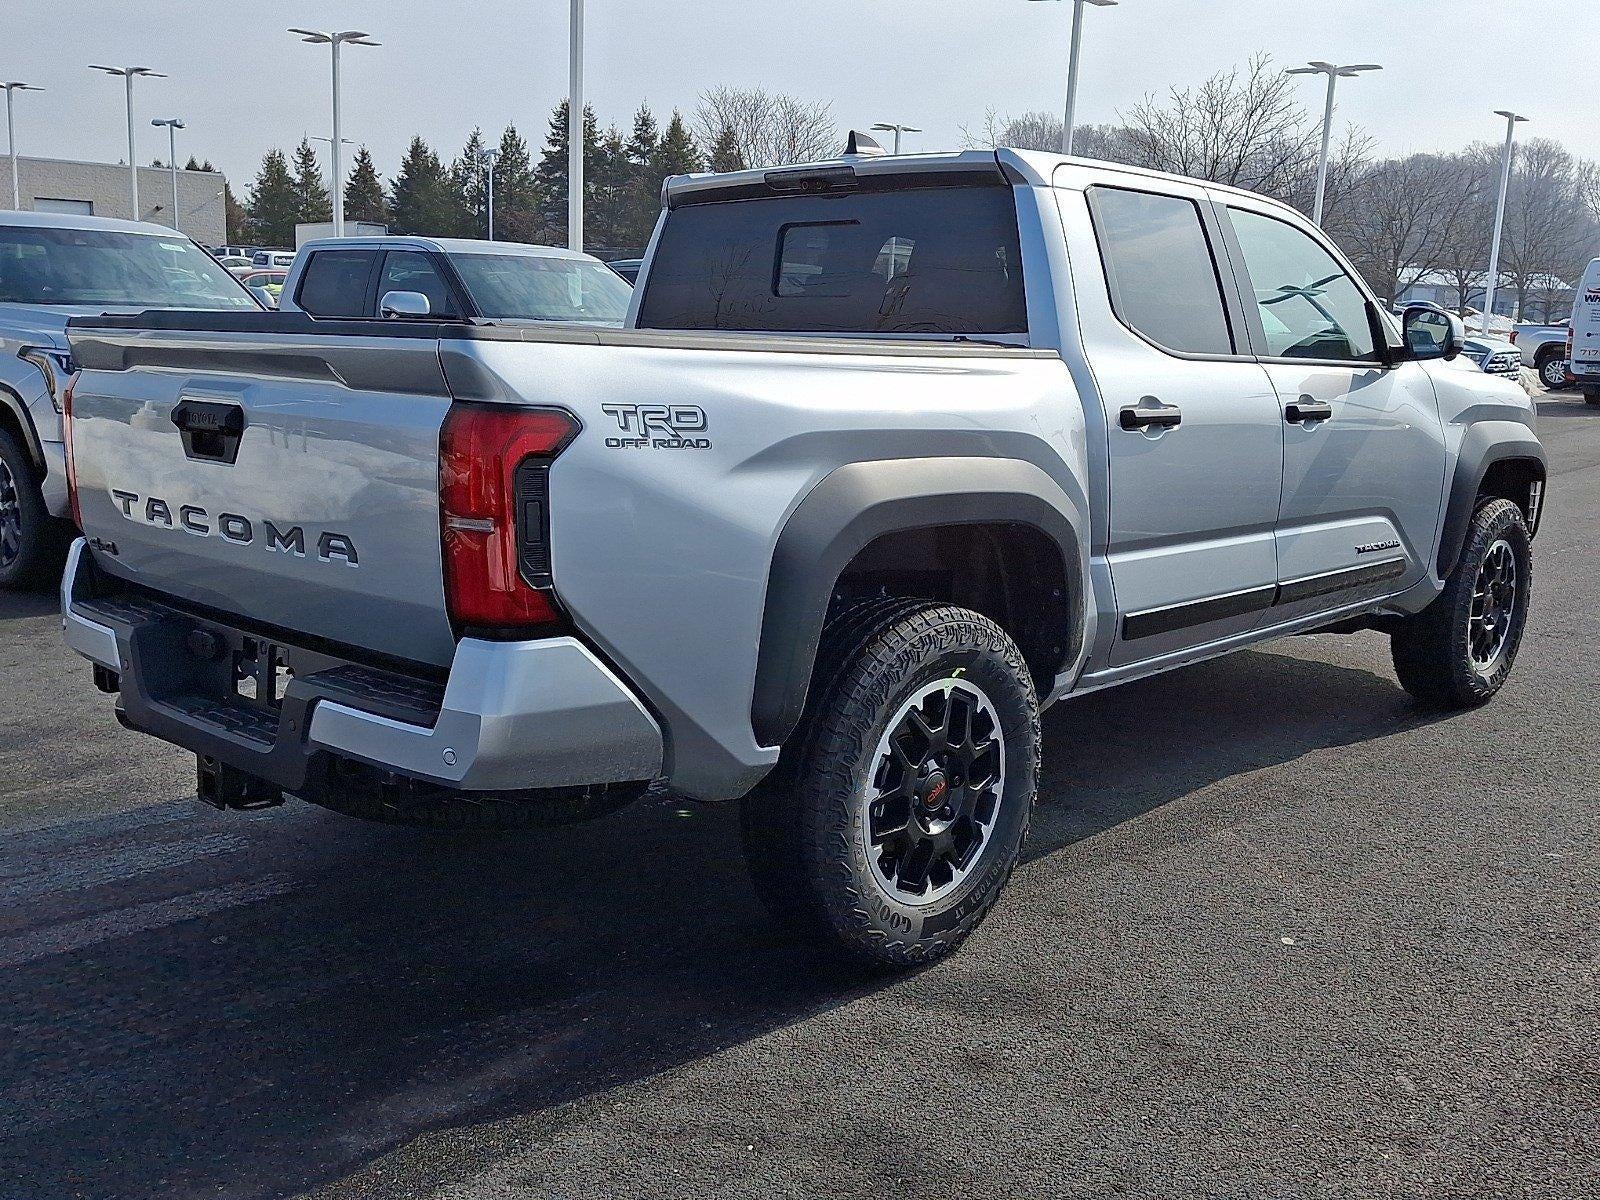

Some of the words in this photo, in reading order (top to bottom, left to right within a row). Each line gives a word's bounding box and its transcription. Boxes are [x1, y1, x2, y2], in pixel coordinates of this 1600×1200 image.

[188, 411, 217, 426] TOYOTA
[601, 403, 708, 438] TRD
[605, 437, 649, 449] OFF
[652, 438, 712, 449] ROAD
[112, 489, 359, 568] TACOMA
[1354, 540, 1401, 554] TACOMA
